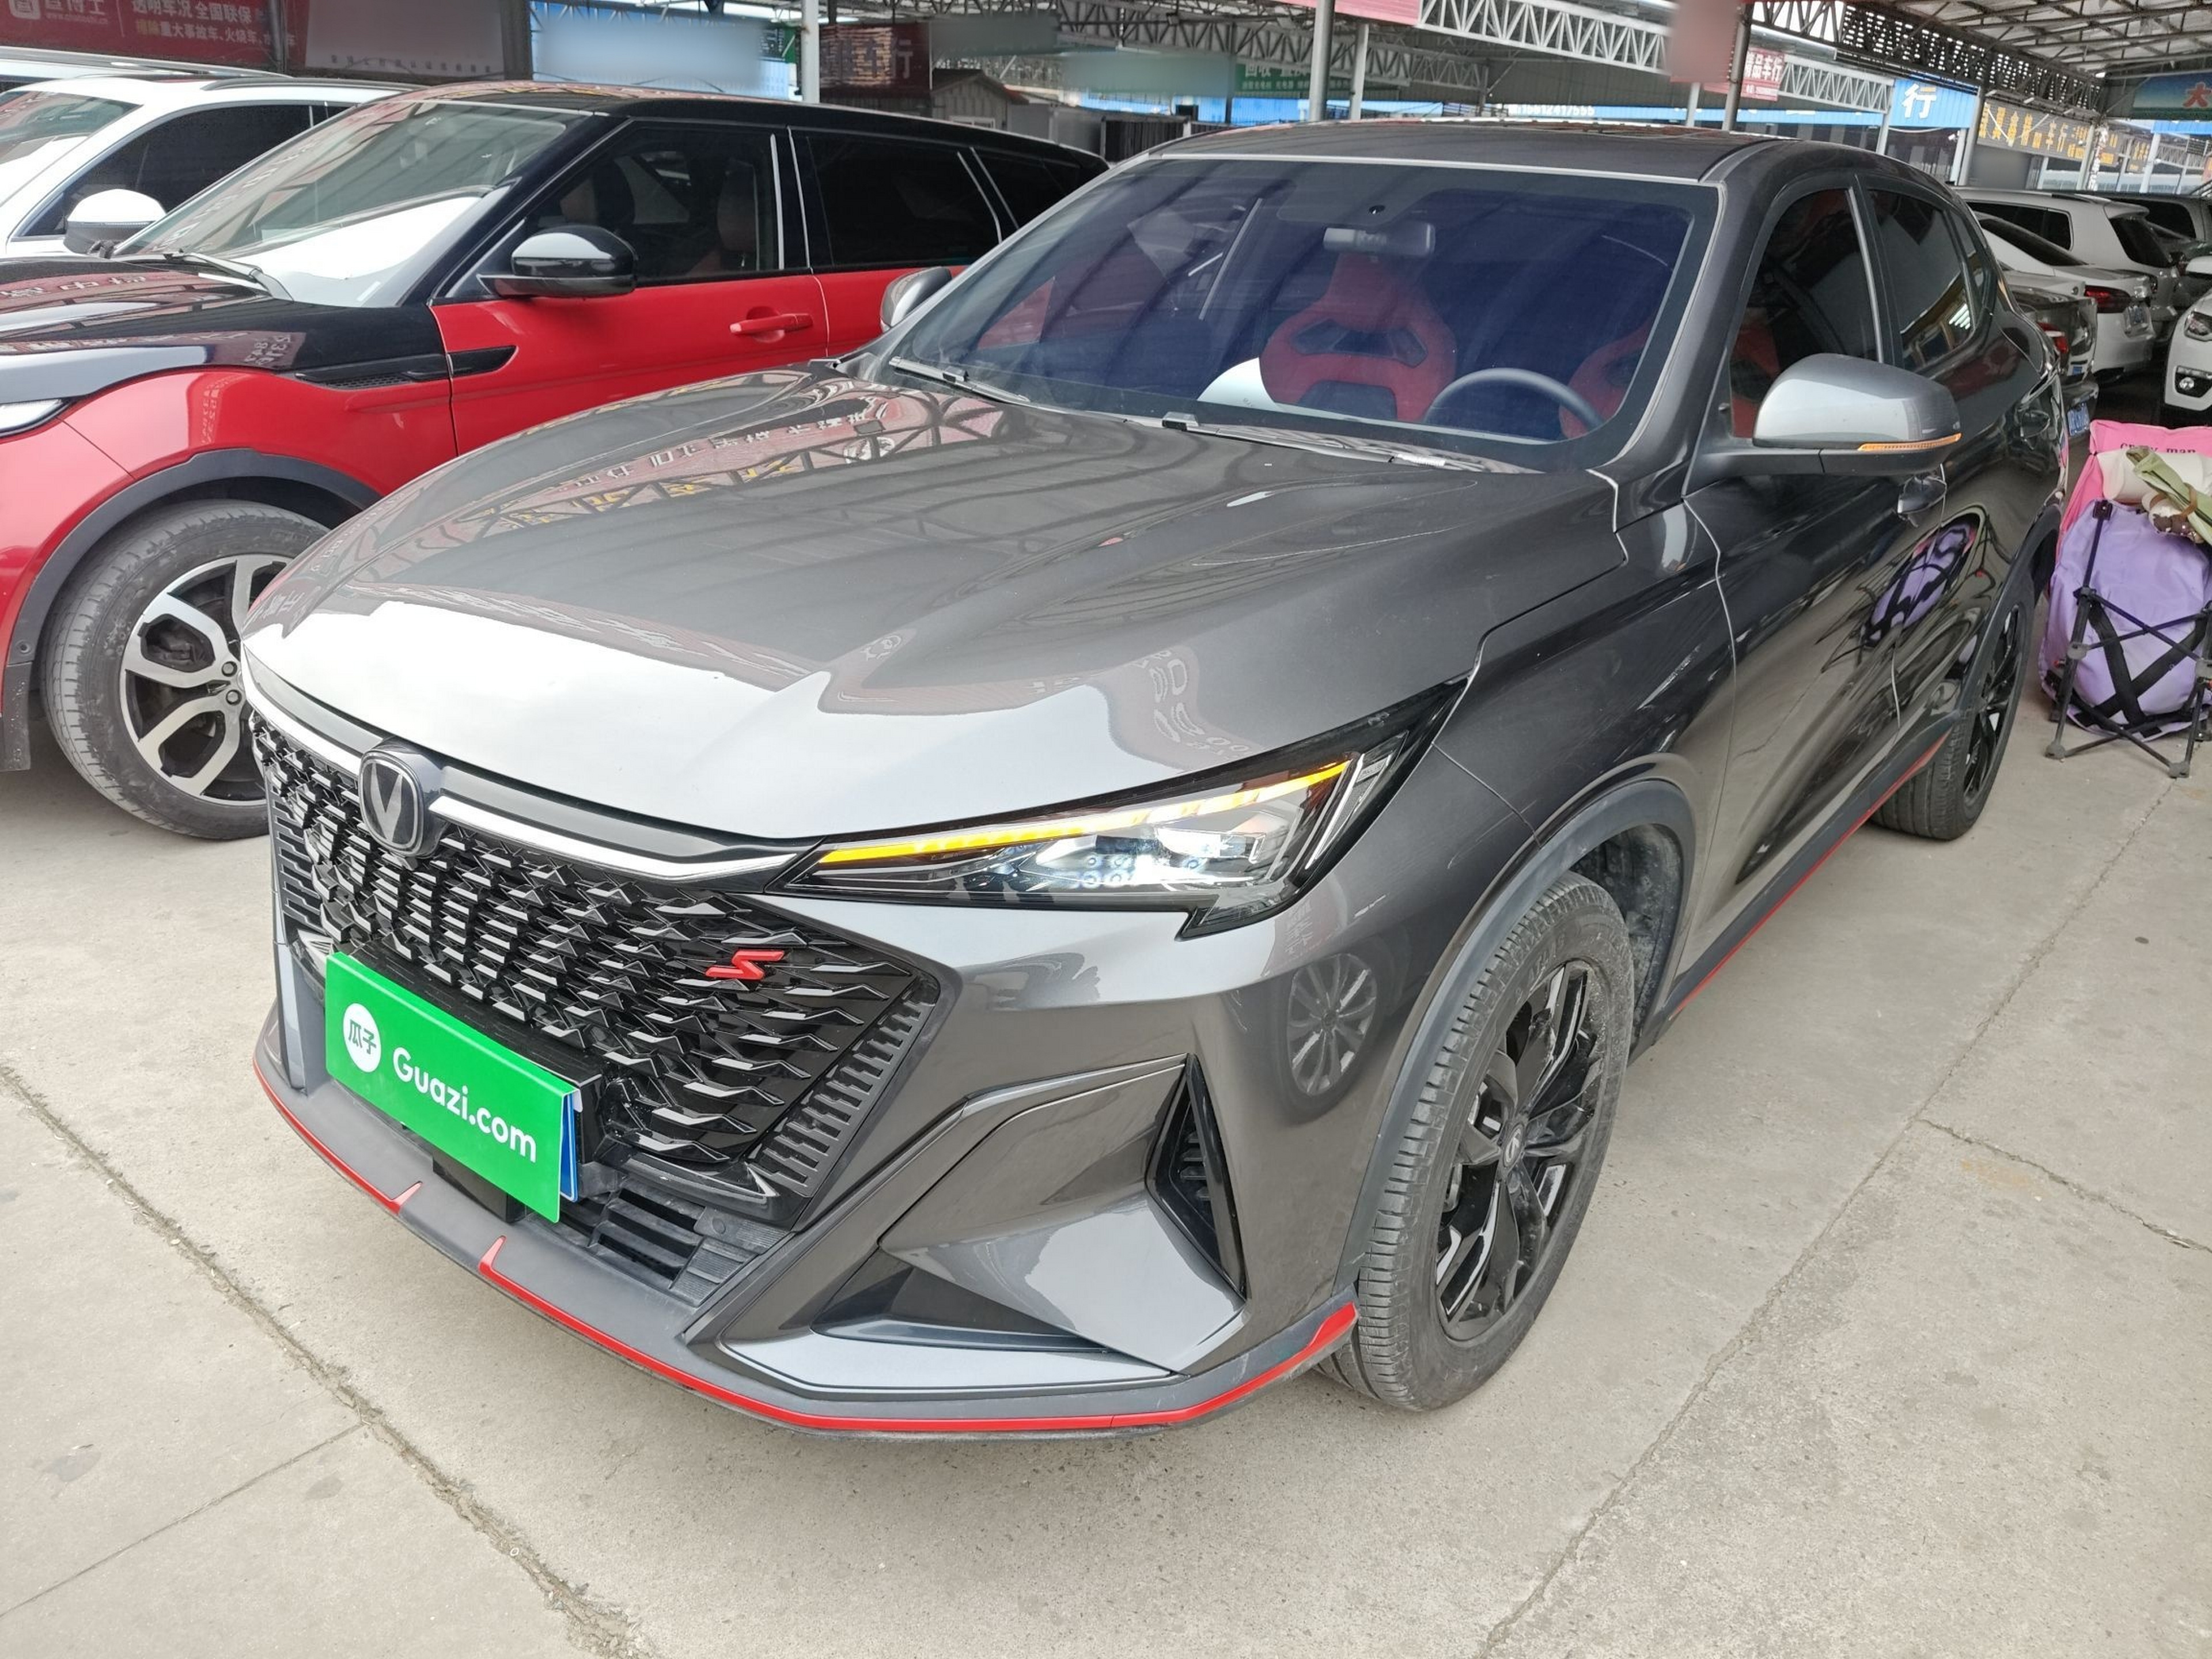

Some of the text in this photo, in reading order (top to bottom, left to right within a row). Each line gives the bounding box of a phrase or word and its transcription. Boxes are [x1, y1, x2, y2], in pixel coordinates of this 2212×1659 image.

[195, 2, 252, 24] 全国联保
[1902, 84, 1937, 119] 行
[2182, 82, 2212, 108] 大
[348, 1020, 377, 1055] 瓜子
[393, 1047, 536, 1163] Guazi.com
